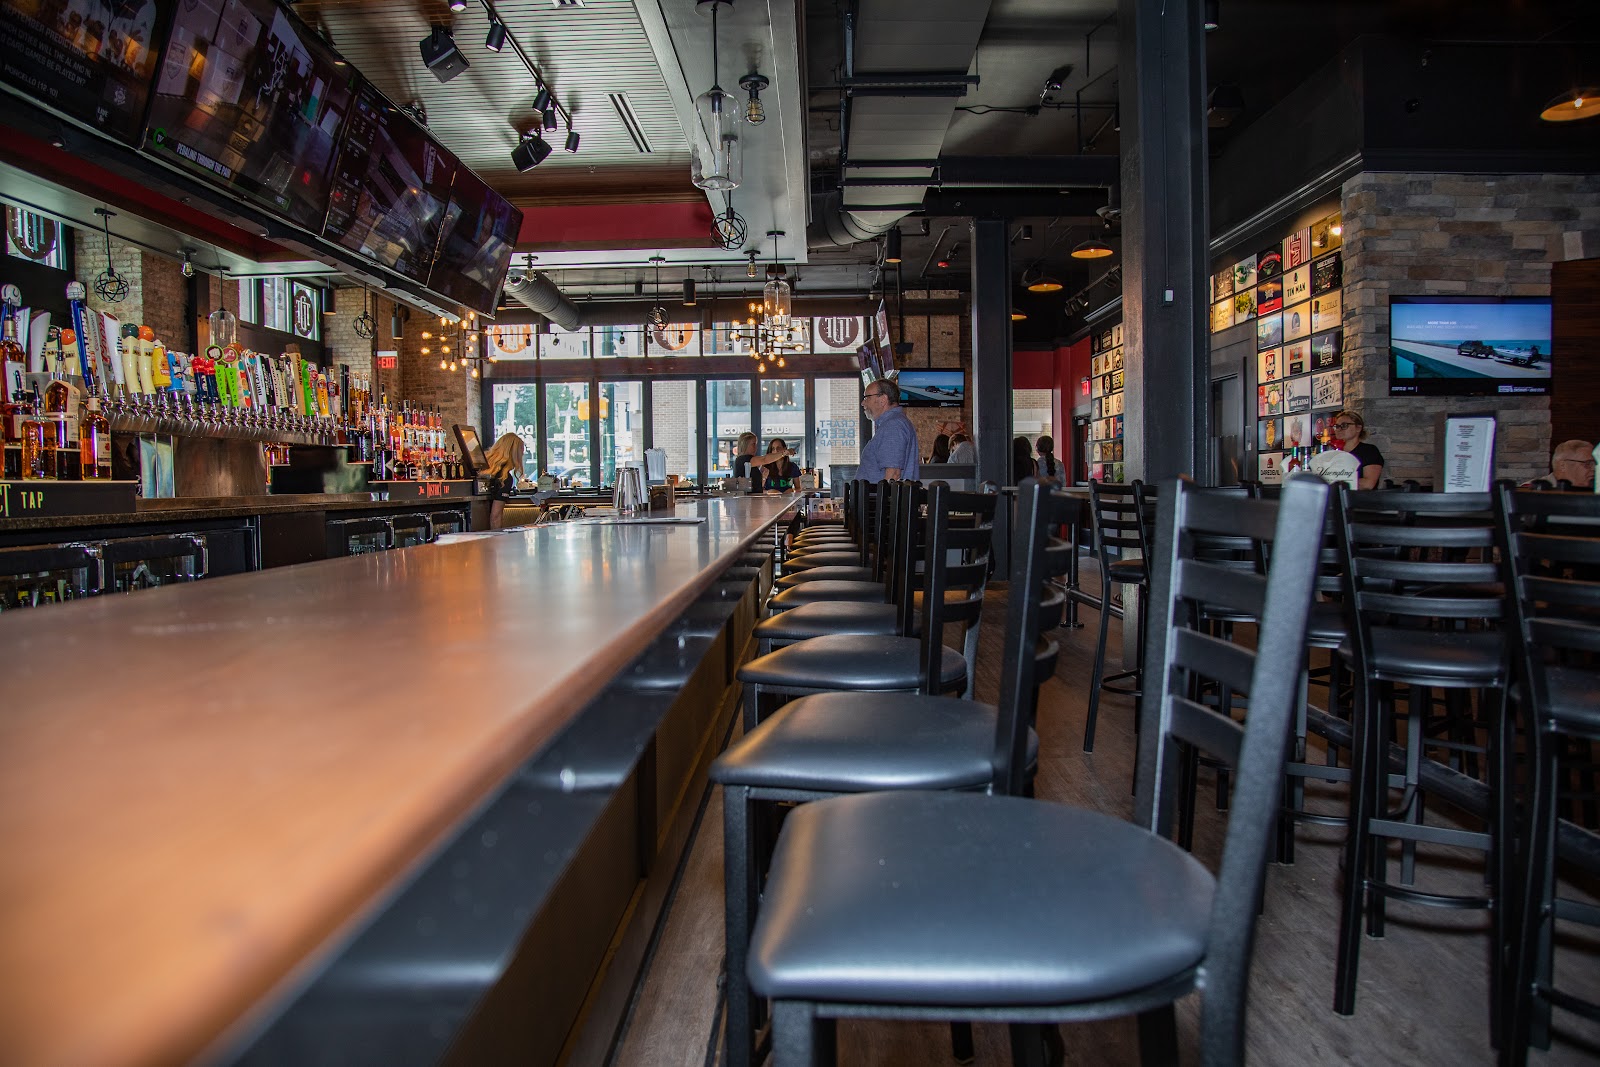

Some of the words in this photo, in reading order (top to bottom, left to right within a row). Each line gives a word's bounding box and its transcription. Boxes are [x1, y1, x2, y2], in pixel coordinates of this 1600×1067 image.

[54, 49, 65, 64] THE
[74, 61, 84, 74] AND
[1287, 287, 1295, 297] TIN
[381, 357, 395, 369] EXIT
[765, 426, 790, 434] CLUB
[1316, 466, 1355, 478] Yuengling
[20, 491, 44, 509] TAP
